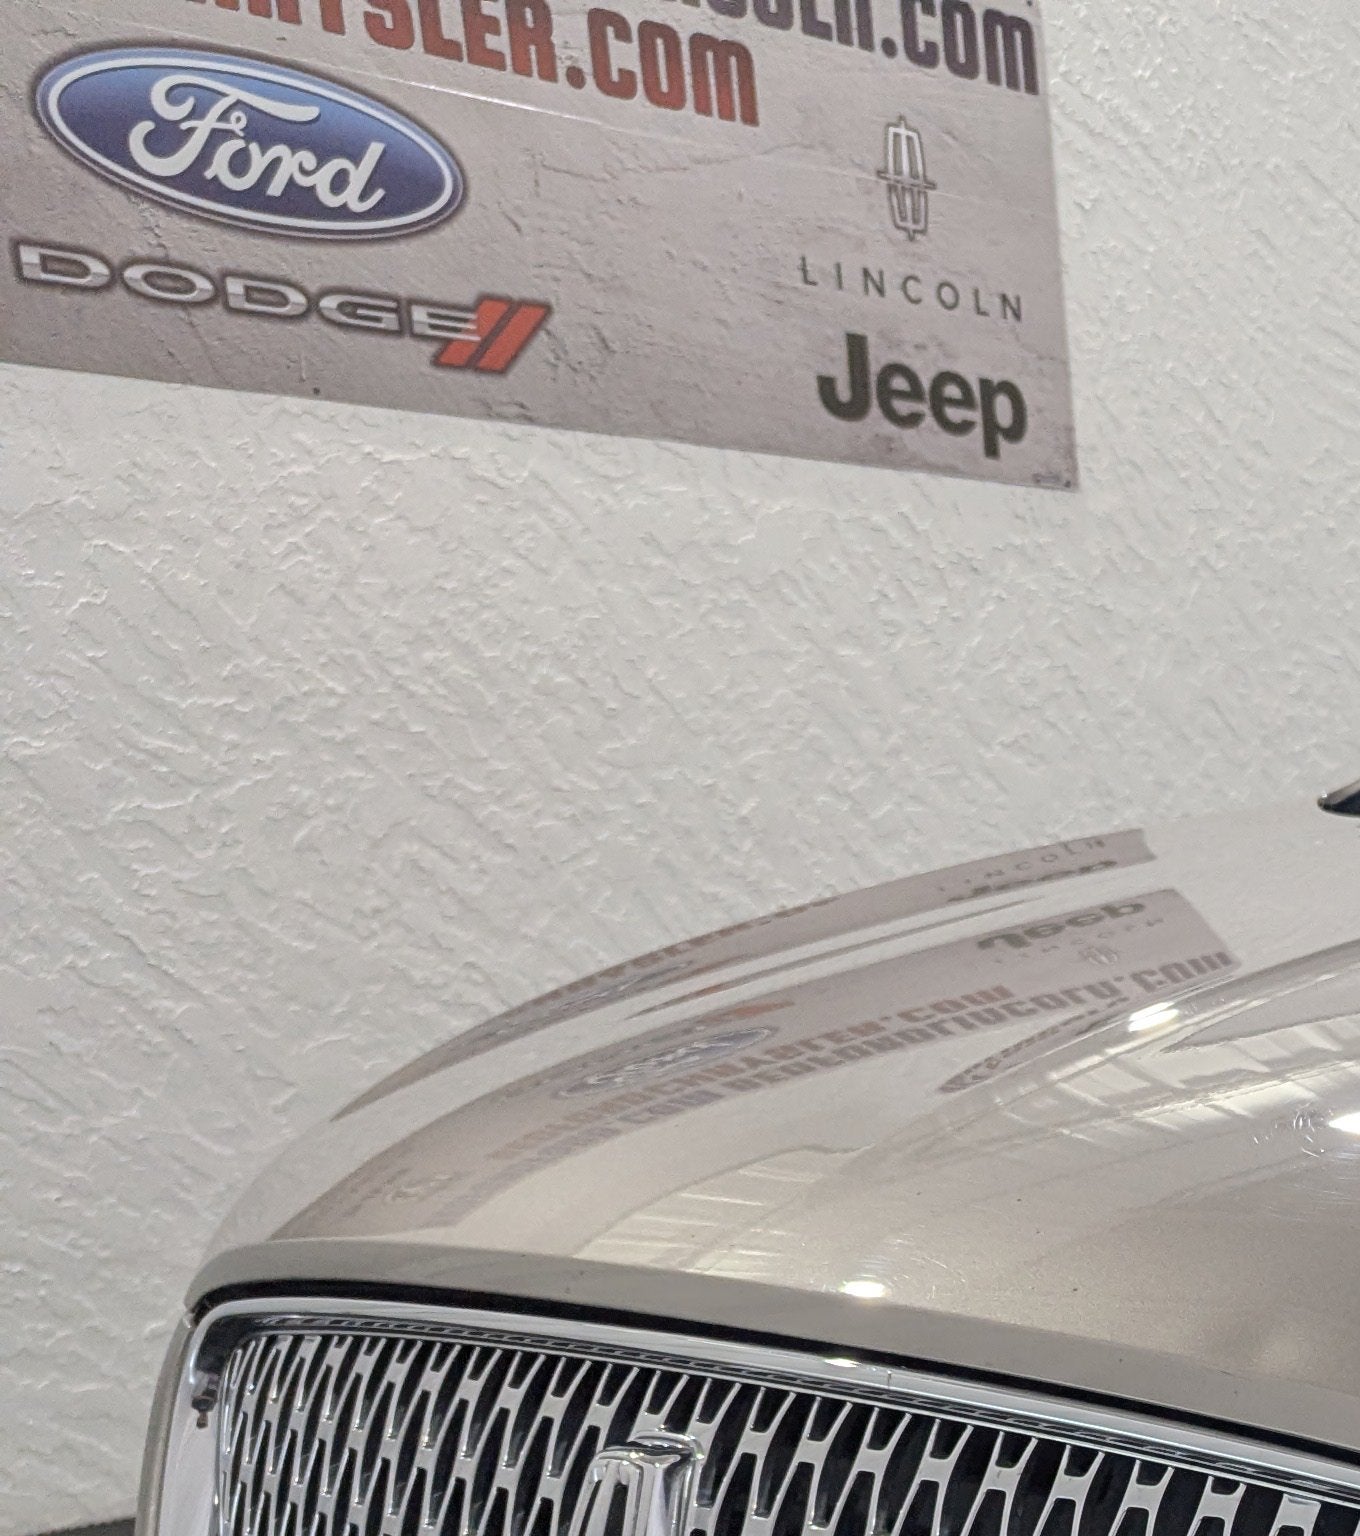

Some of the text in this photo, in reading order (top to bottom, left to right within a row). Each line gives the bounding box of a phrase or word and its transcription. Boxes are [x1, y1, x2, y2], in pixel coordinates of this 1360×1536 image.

[129, 74, 387, 214] Ford
[16, 244, 482, 342] DODGE
[799, 255, 1023, 323] LINCOLN
[815, 332, 1029, 460] Jeep
